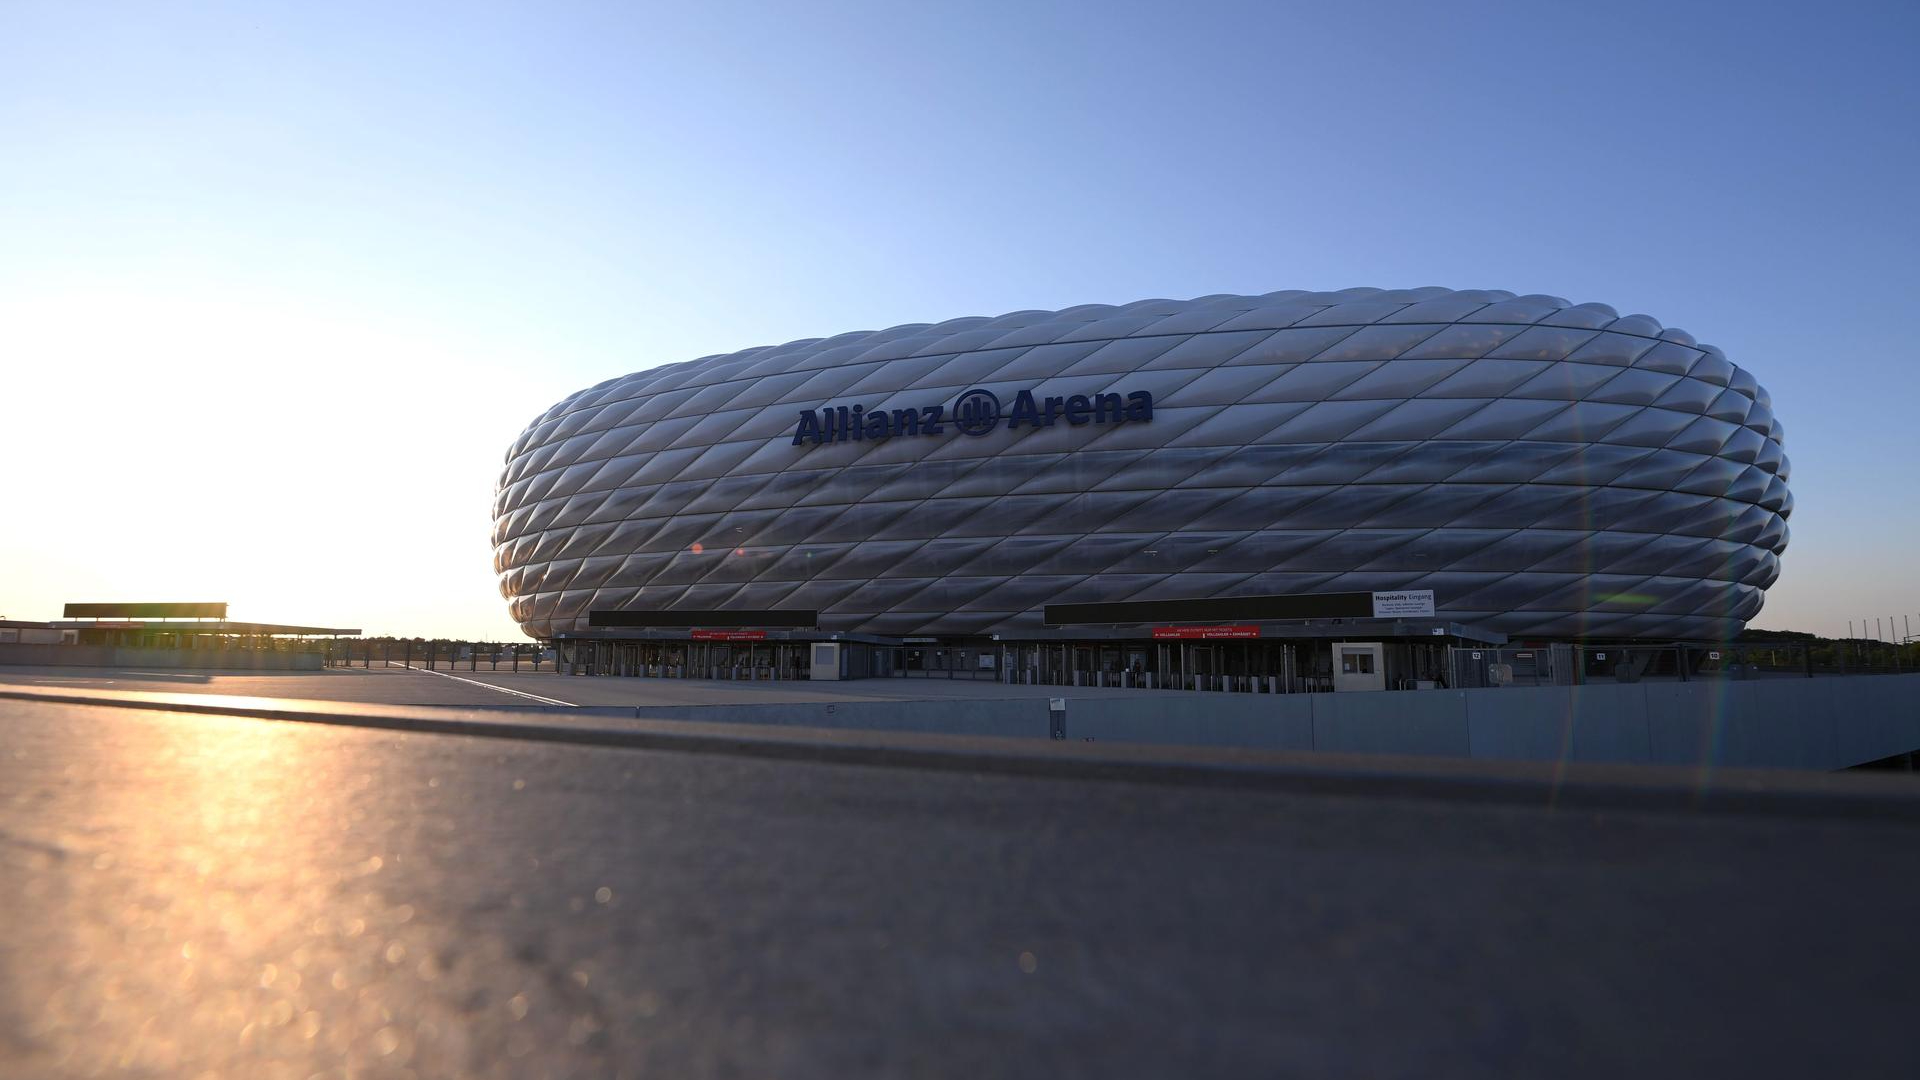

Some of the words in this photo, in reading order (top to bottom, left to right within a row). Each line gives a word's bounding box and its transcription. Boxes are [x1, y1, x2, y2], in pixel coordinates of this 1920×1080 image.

[792, 404, 944, 446] Allianz
[1008, 389, 1154, 429] Arena
[1375, 594, 1407, 602] Hospitality
[1408, 593, 1432, 601] Eingang
